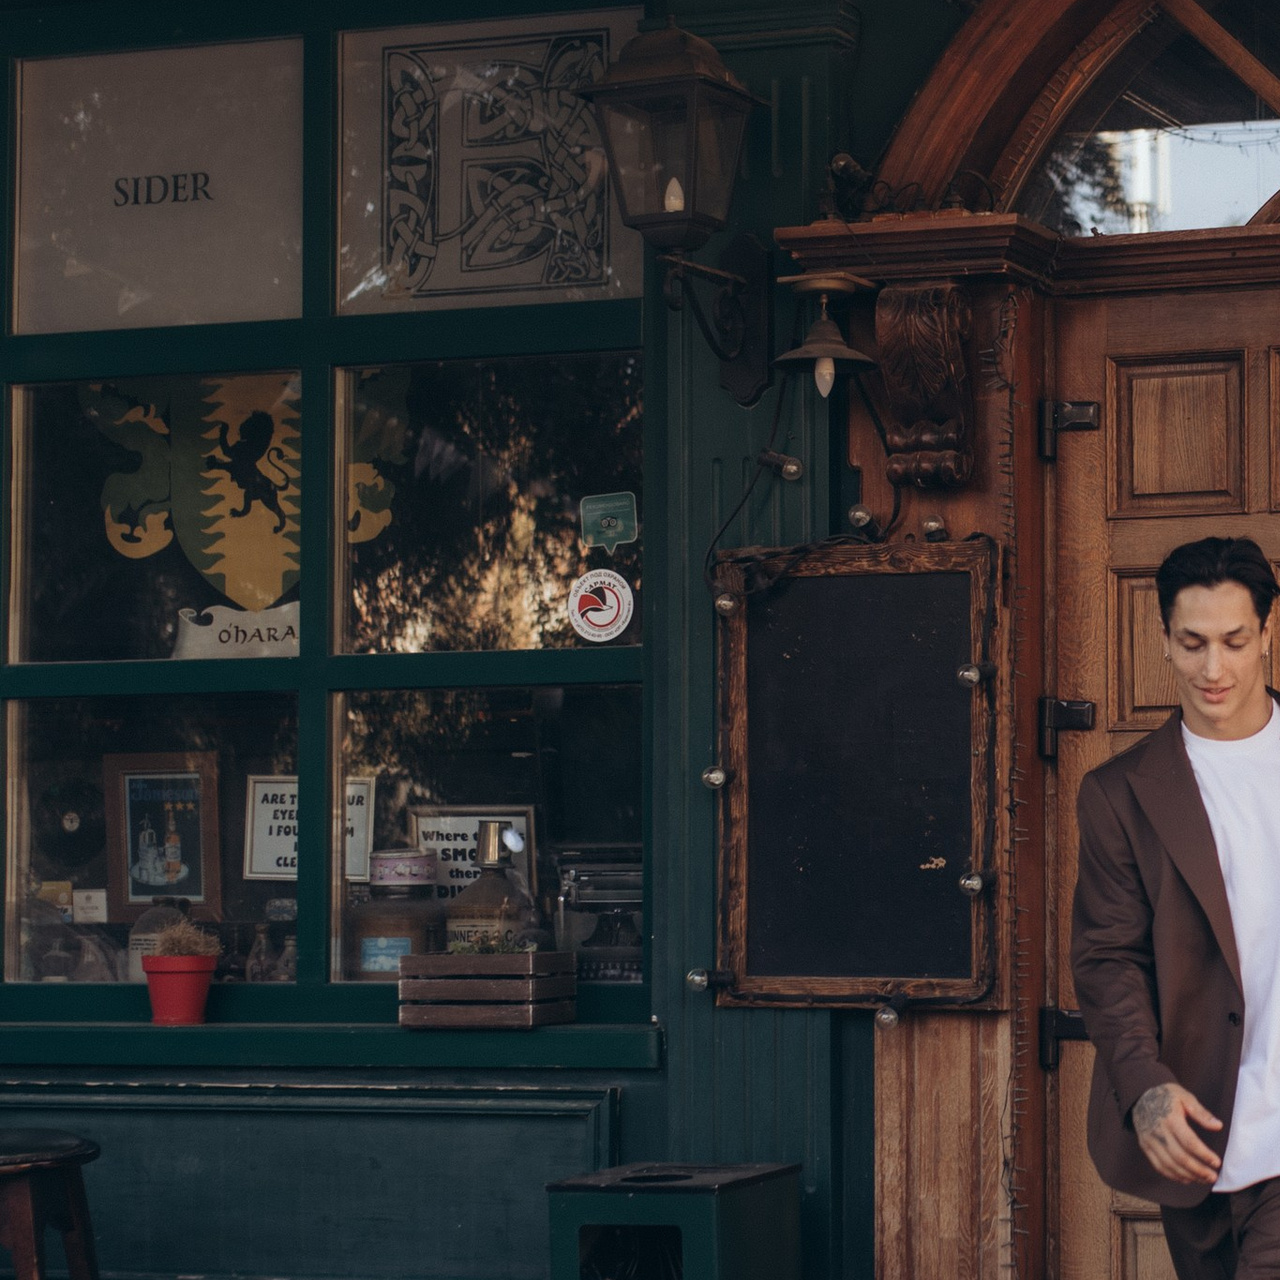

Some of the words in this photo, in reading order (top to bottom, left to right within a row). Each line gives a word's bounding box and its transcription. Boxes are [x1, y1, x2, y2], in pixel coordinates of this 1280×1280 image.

[112, 172, 214, 207] SIDER
[585, 580, 617, 593] САРМАТ
[261, 793, 286, 805] ARE
[277, 825, 298, 836] FOU
[421, 831, 469, 841] Where
[441, 848, 477, 862] SMO
[449, 868, 481, 878] ther
